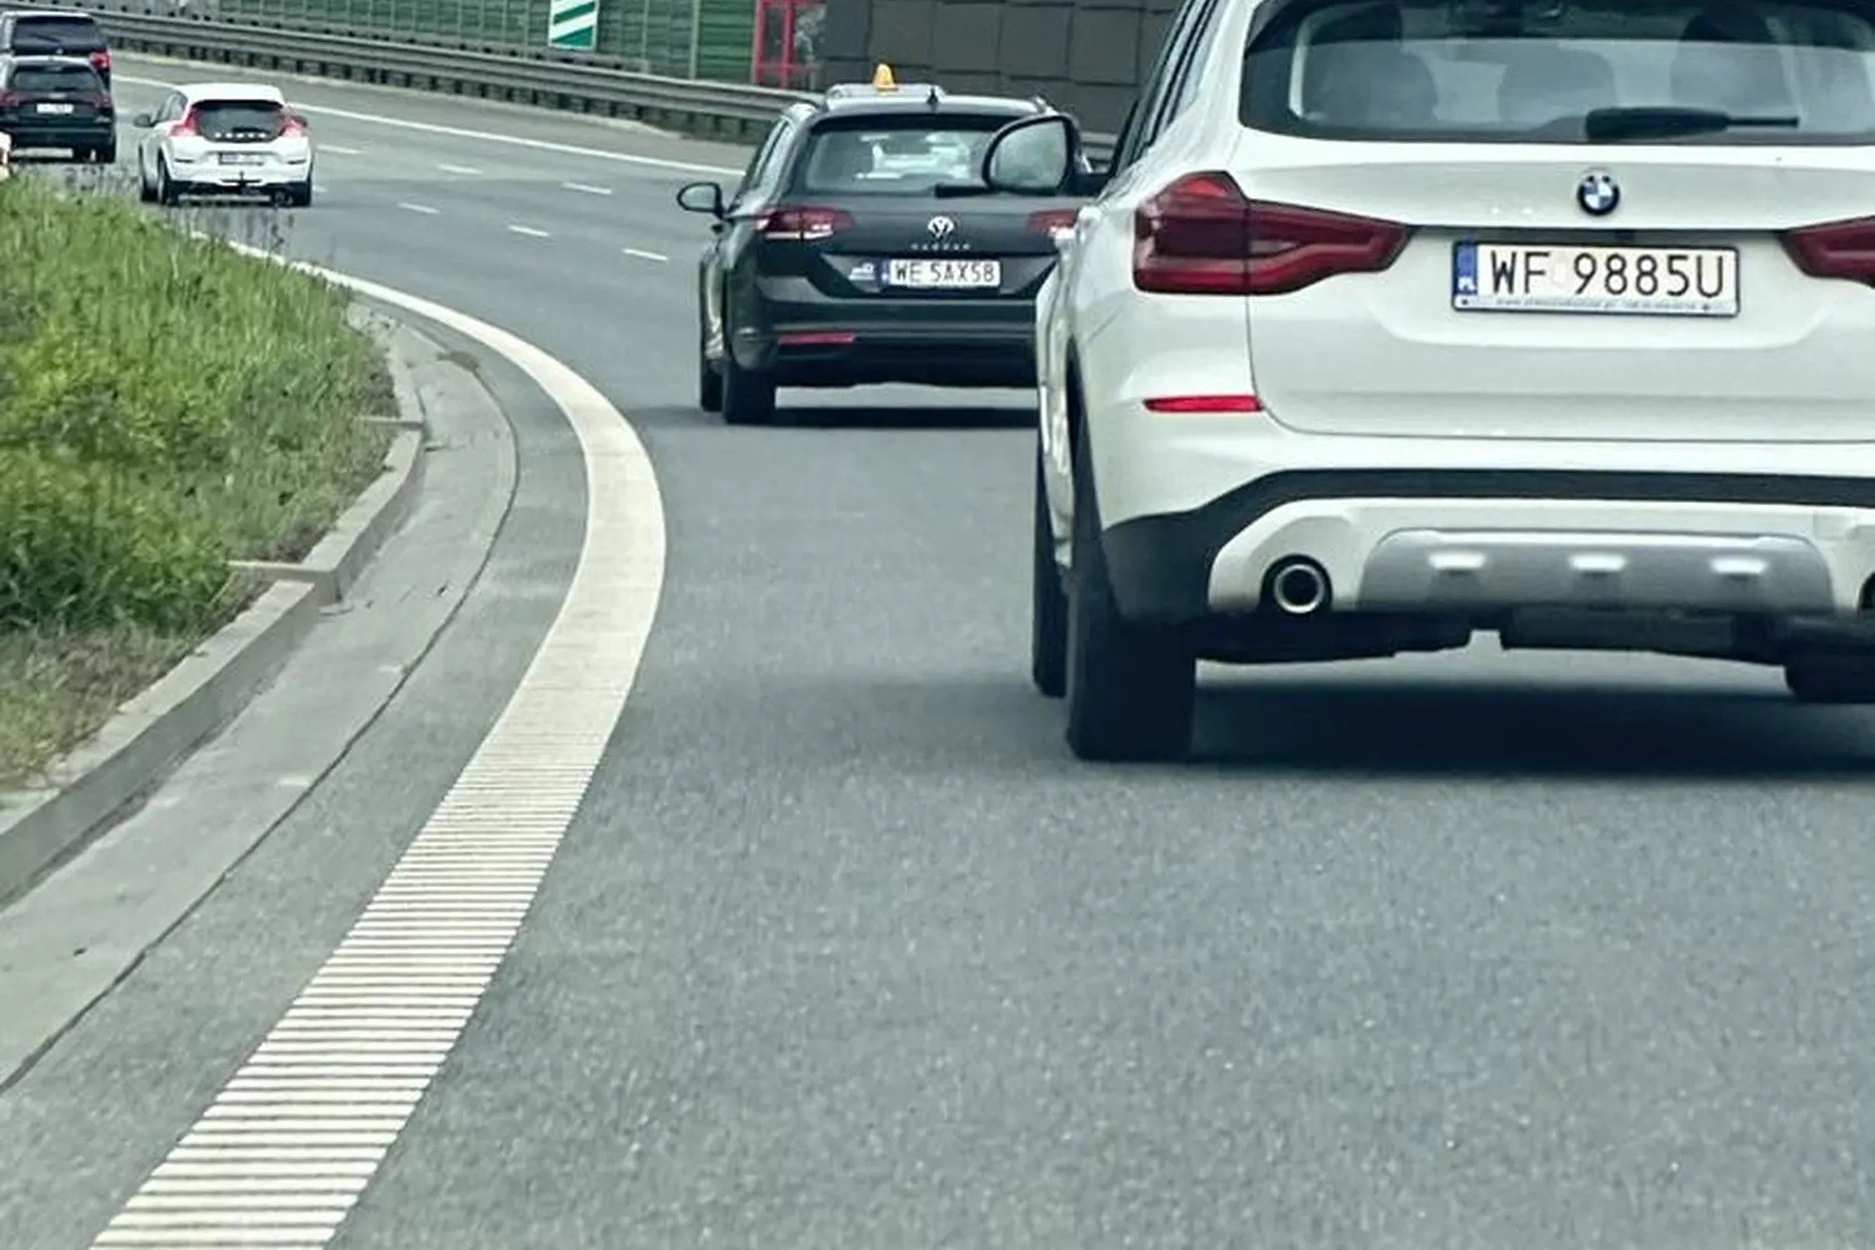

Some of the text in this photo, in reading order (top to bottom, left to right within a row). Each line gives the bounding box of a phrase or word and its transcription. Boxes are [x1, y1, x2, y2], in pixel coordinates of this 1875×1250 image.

[895, 261, 921, 282] WE
[1490, 250, 1724, 298] WF 9885U
